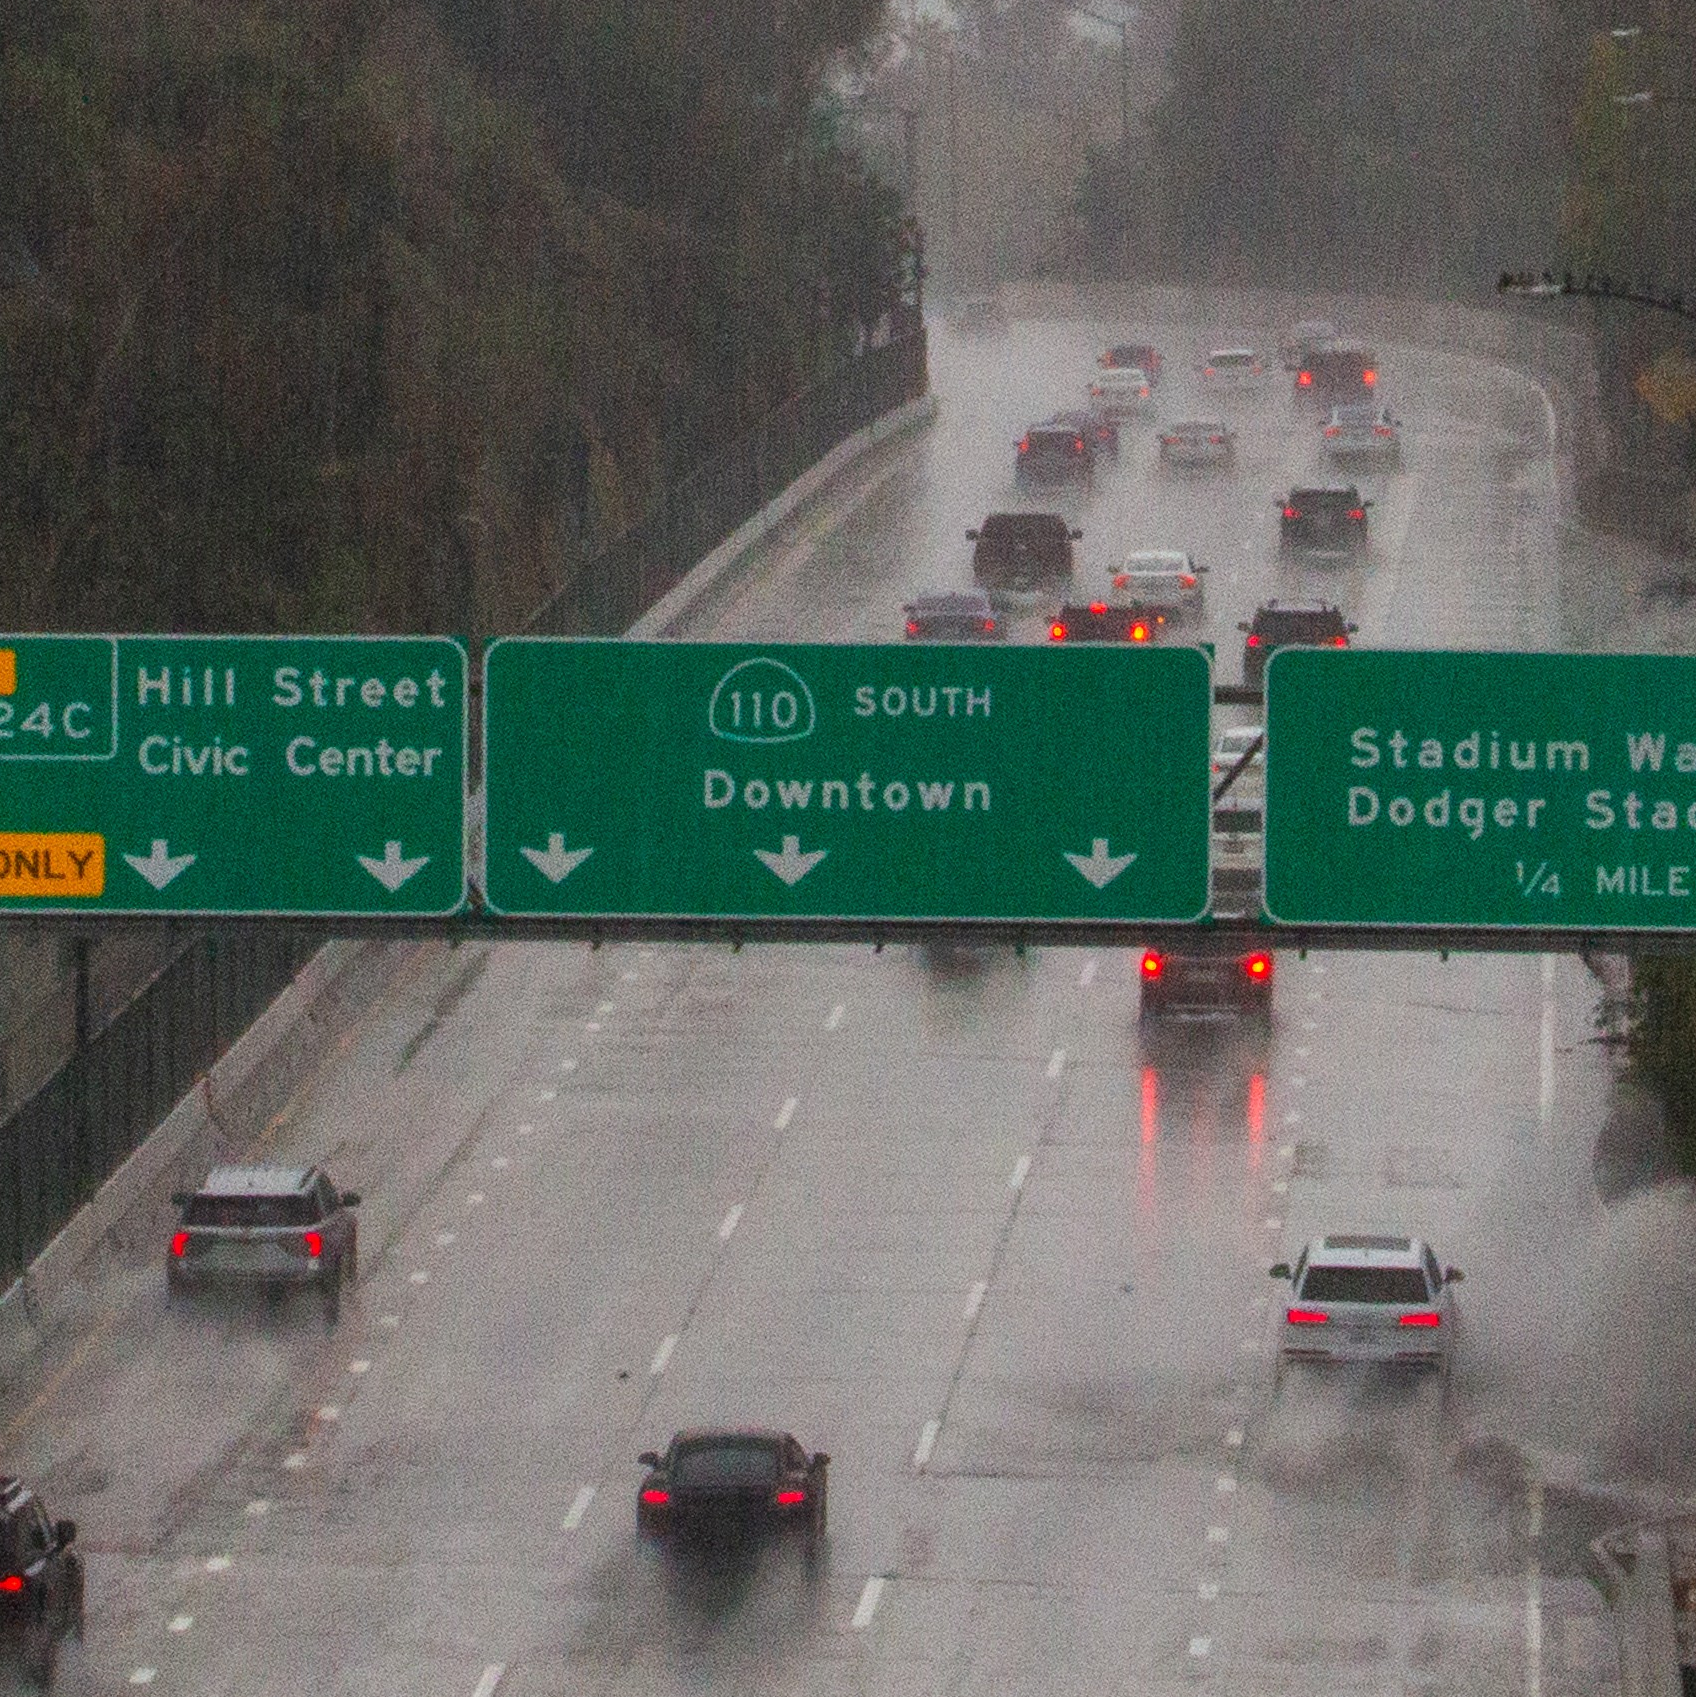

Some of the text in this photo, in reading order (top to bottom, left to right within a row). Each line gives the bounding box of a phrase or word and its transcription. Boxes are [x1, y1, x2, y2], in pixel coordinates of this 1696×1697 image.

[137, 666, 446, 708] Hill Street
[730, 685, 991, 729] 110 SOUTH
[138, 735, 442, 777] Civic Center
[1350, 727, 1590, 771] Stadium
[703, 769, 991, 811] Downtown
[1347, 786, 1546, 840] Dodger
[1596, 866, 1690, 897] MILE
